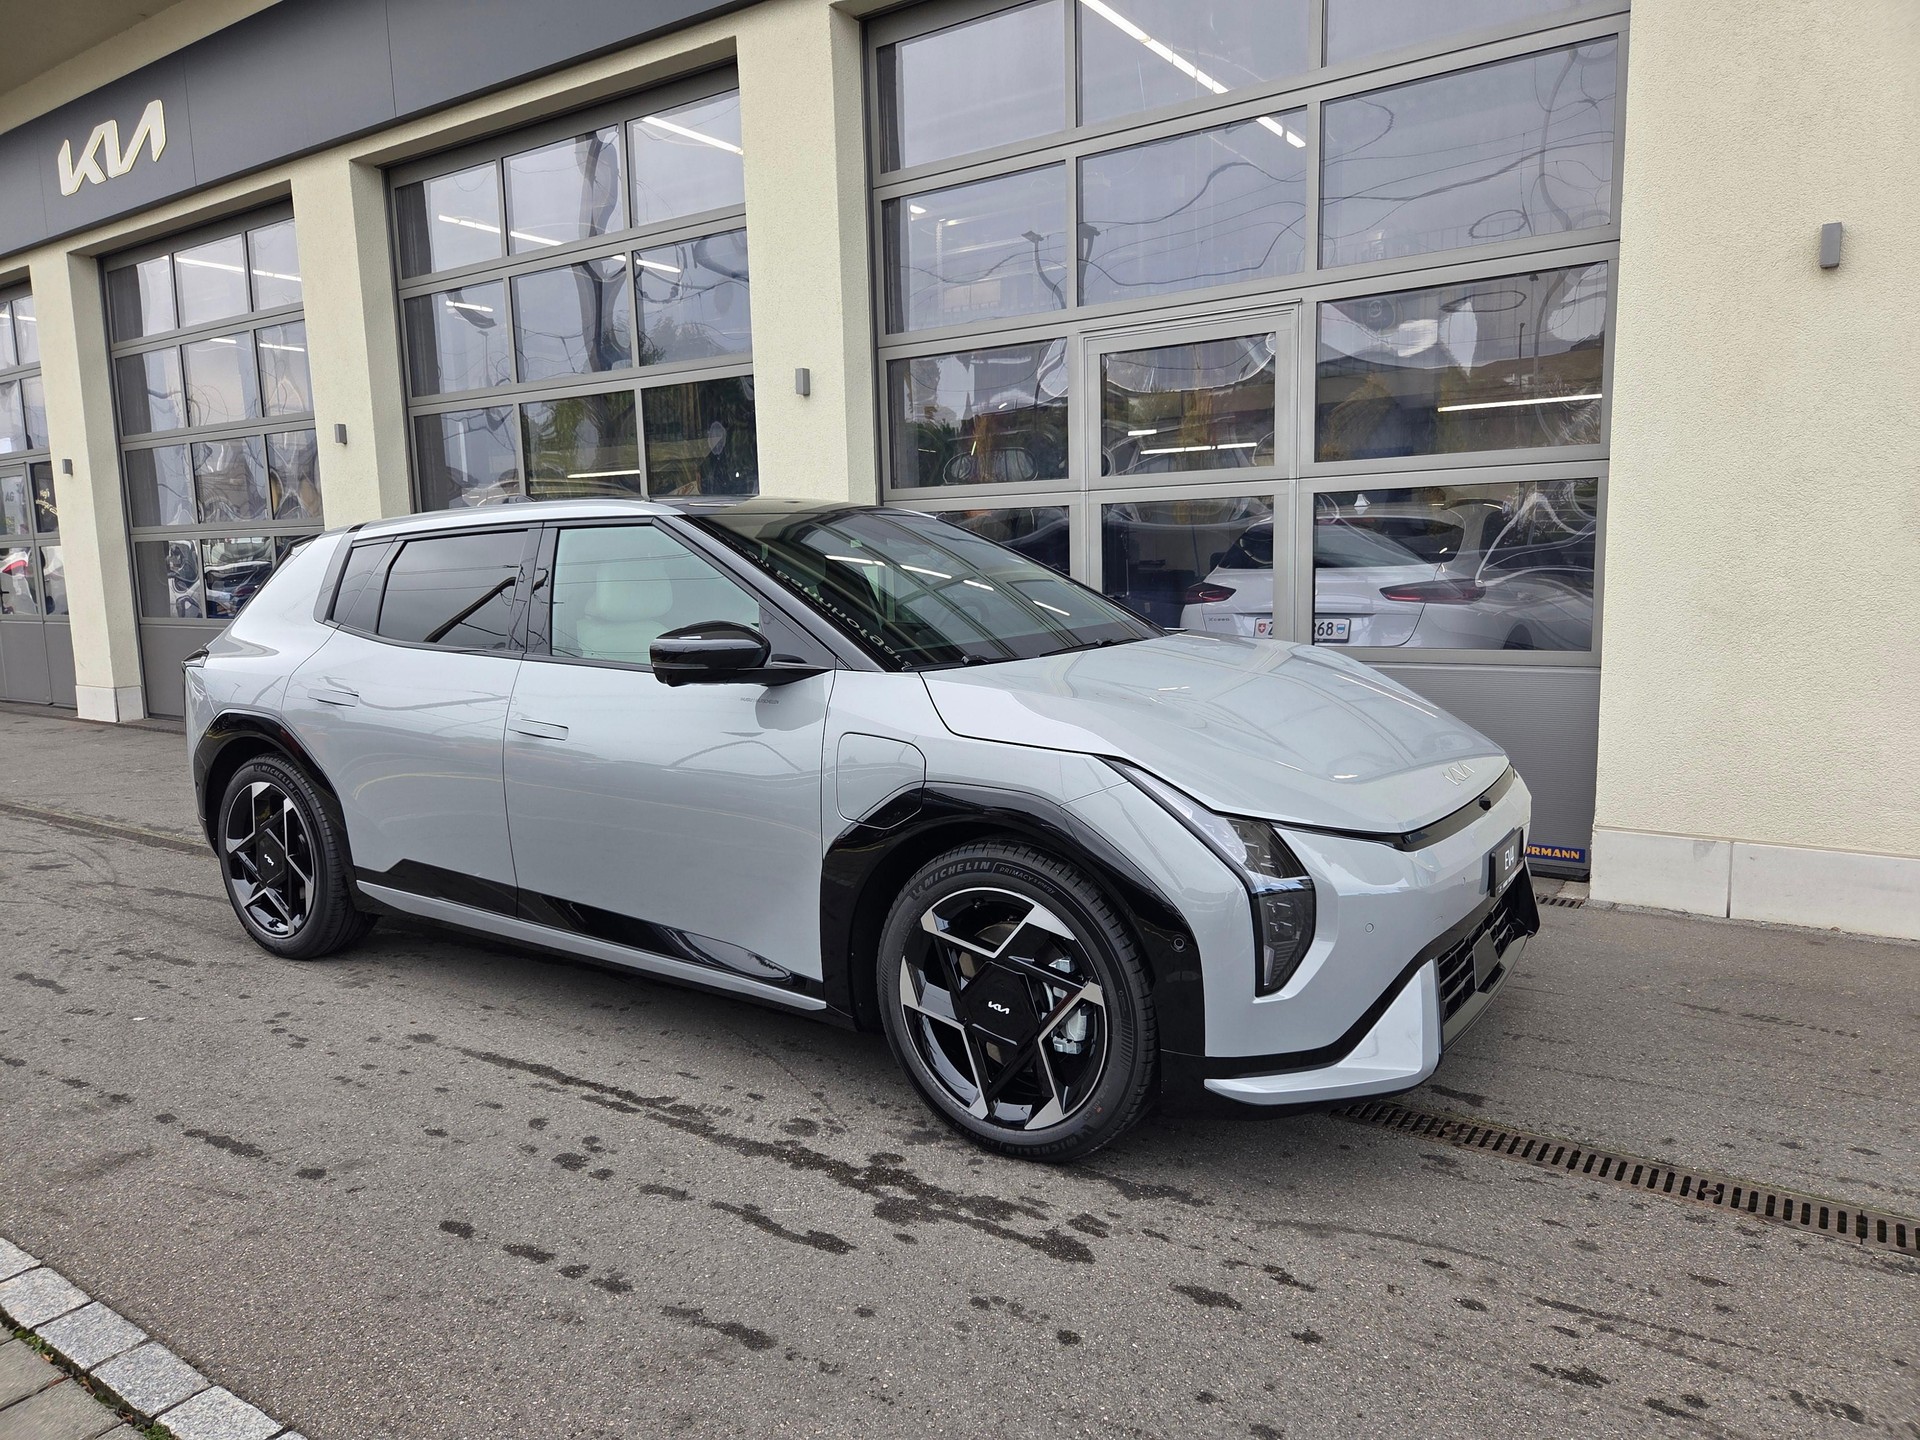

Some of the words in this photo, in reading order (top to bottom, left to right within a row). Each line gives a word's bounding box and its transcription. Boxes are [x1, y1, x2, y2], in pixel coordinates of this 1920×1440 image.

[58, 100, 167, 196] KIA
[1315, 622, 1334, 637] 68
[924, 861, 991, 887] MICHELIN
